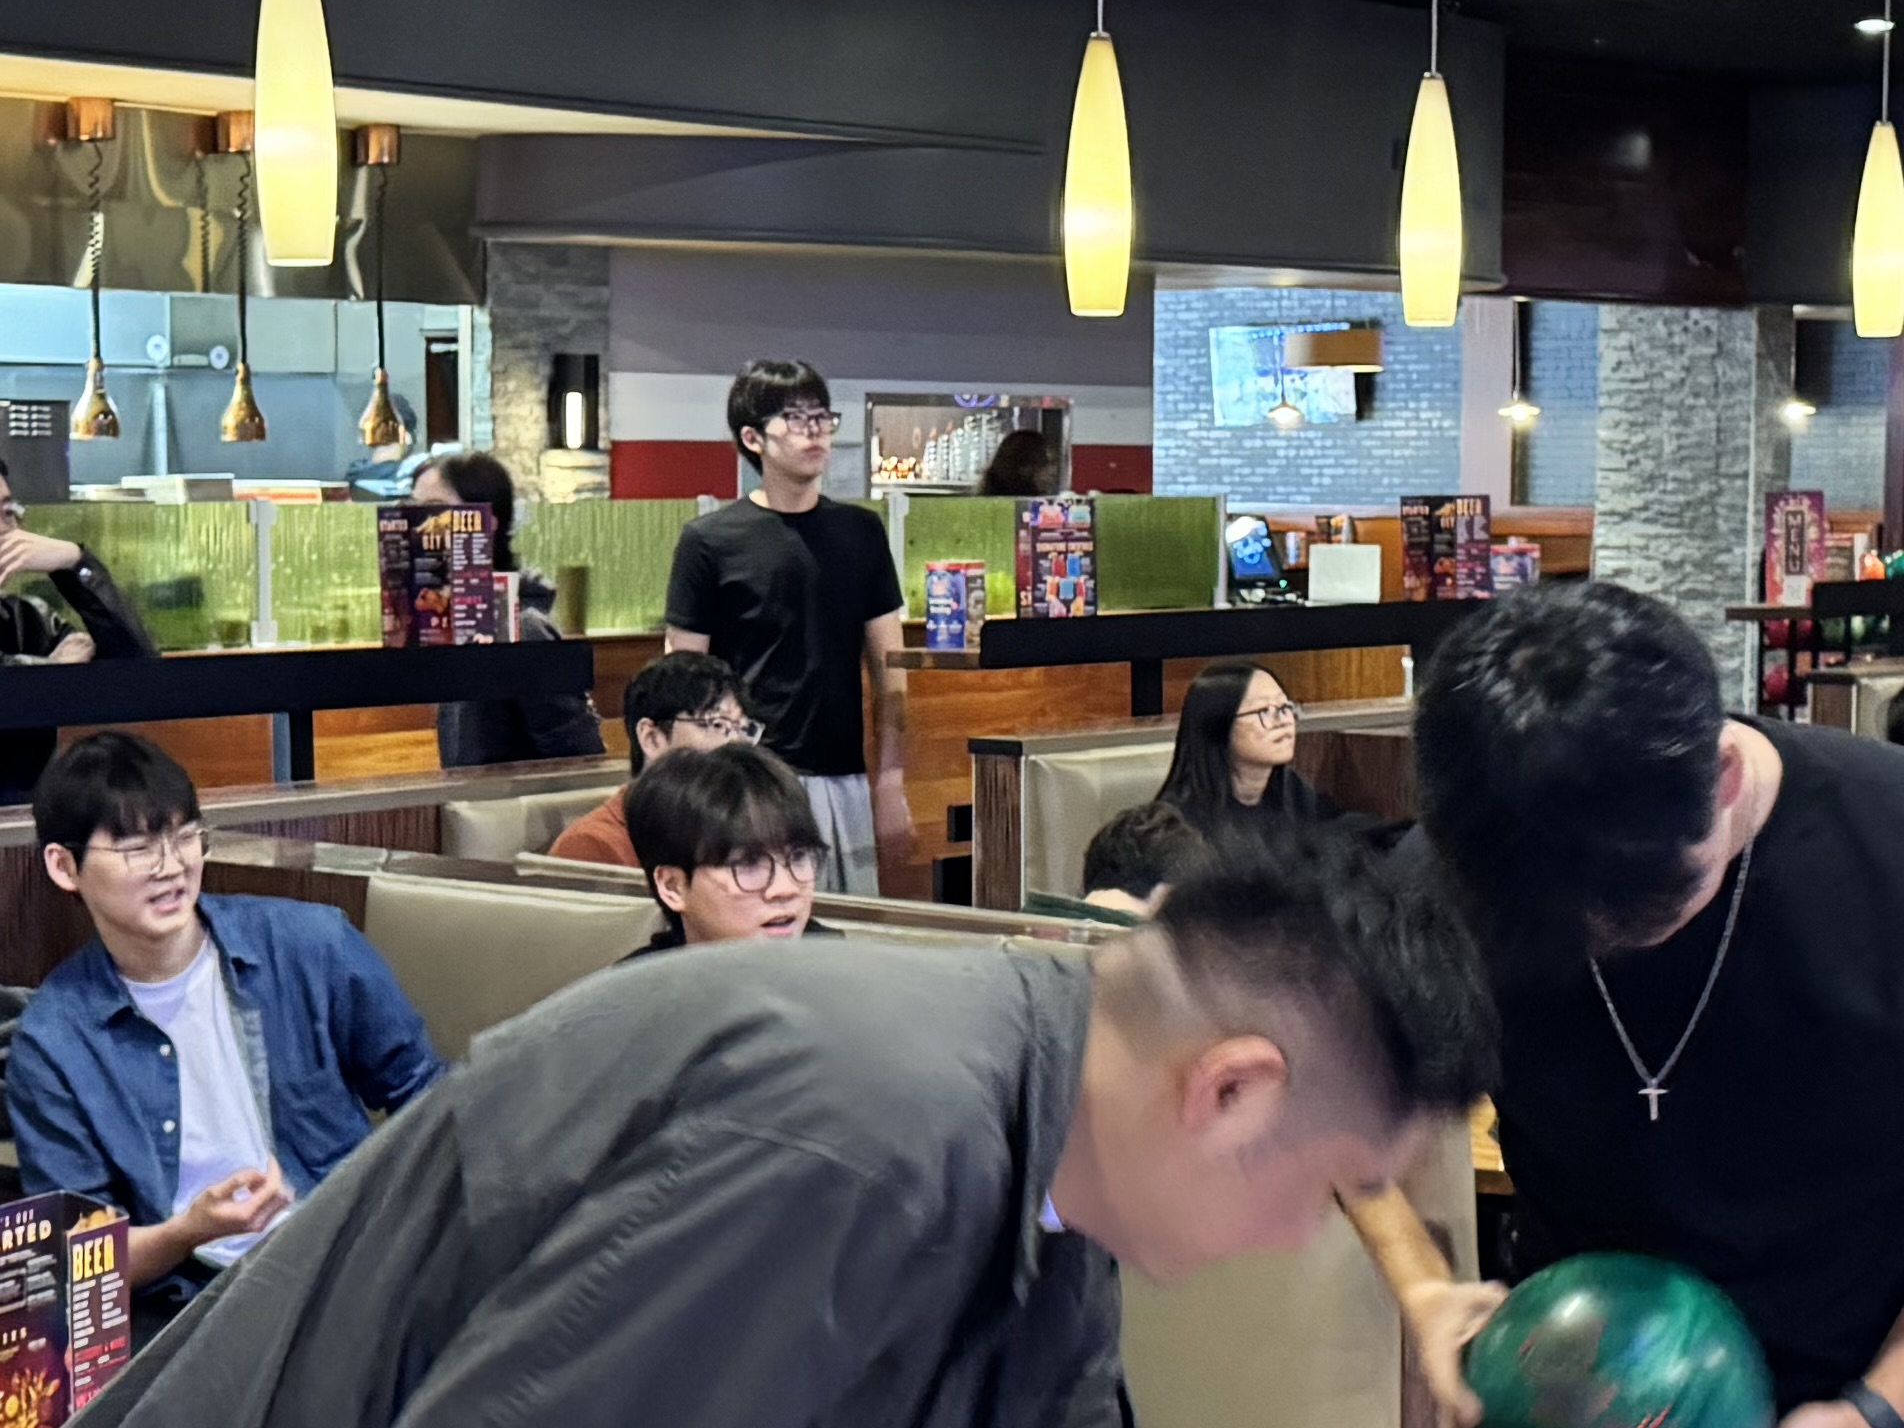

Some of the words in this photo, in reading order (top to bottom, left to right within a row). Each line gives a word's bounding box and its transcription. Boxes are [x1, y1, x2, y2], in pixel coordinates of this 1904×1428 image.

[453, 510, 481, 532] BEER
[1788, 514, 1802, 572] MENU
[72, 1234, 115, 1282] BEER
